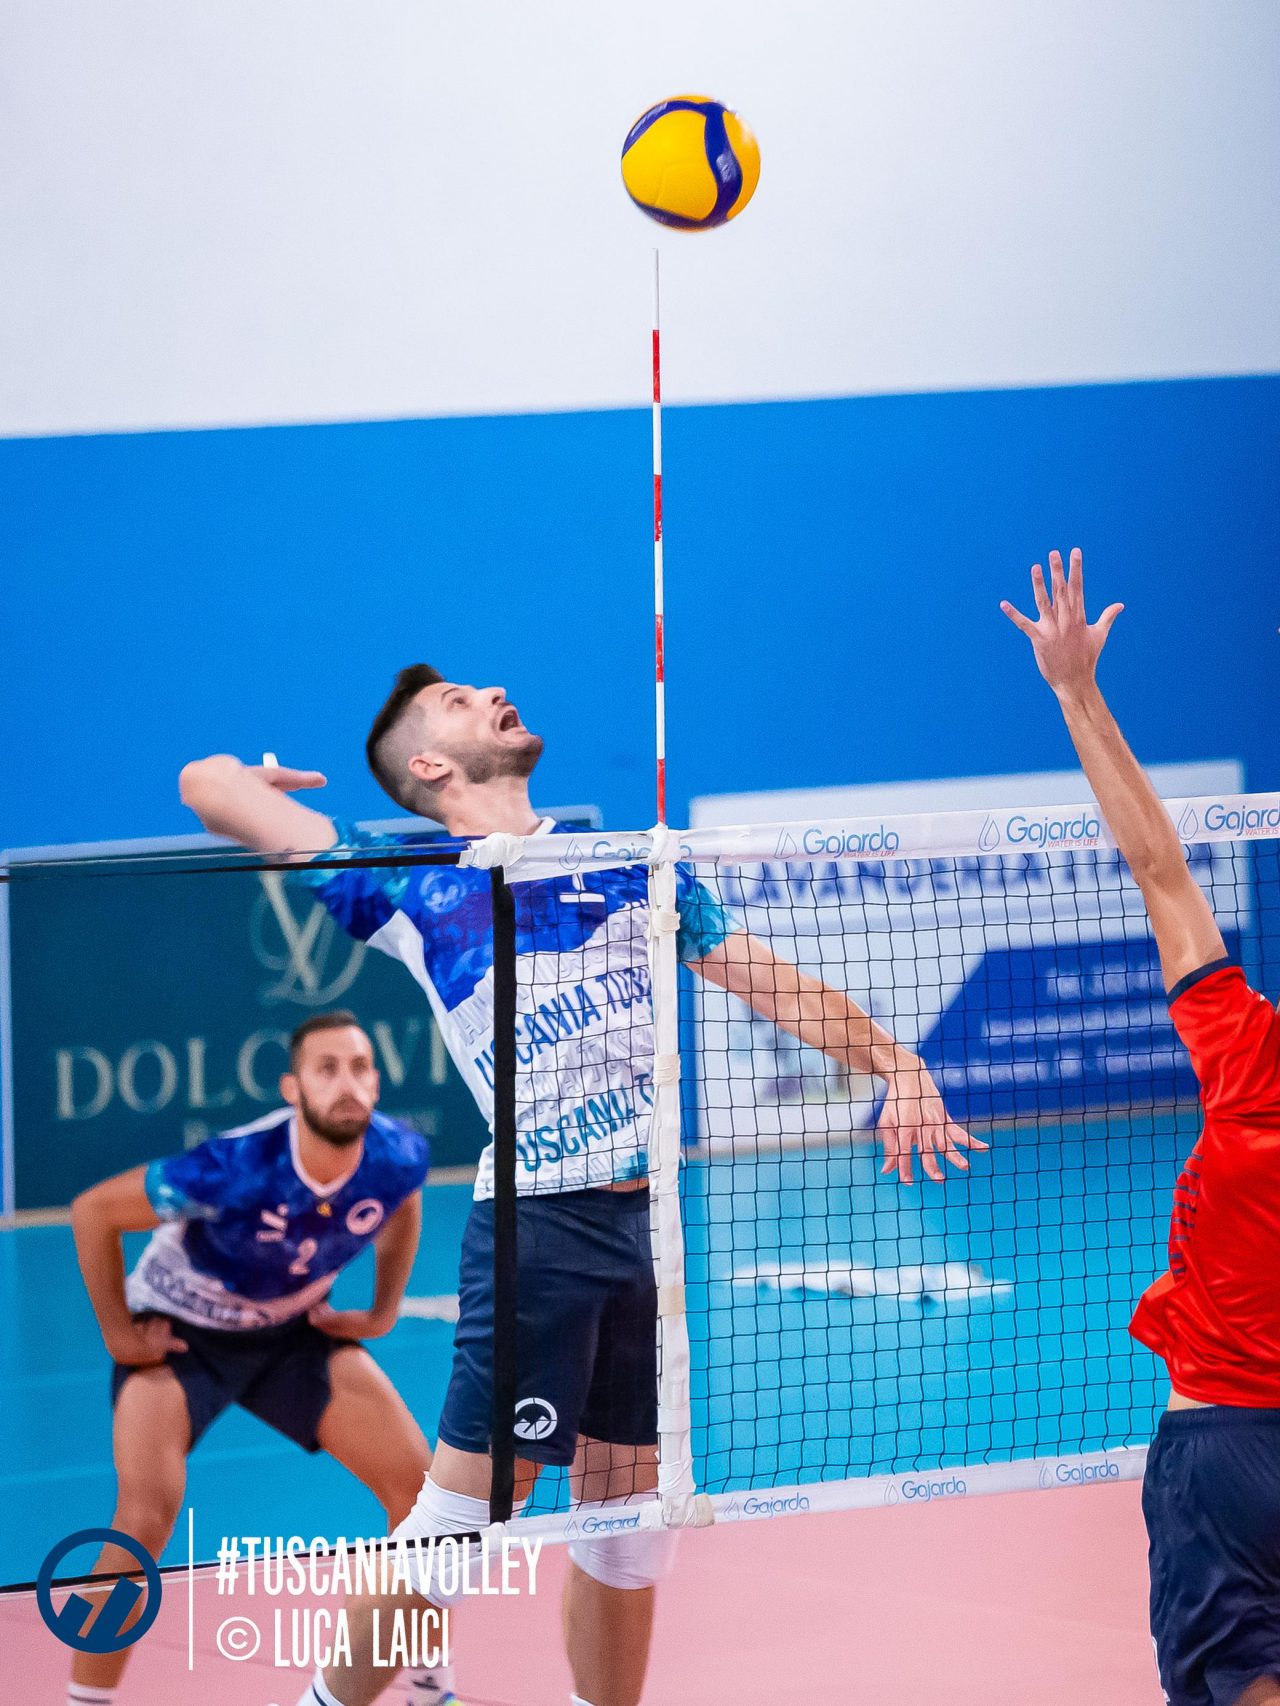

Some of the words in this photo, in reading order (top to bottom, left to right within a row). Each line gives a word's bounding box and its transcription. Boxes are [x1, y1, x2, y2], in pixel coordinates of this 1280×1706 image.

[803, 824, 900, 858] Gajarda
[1007, 813, 1100, 848] Gajarda
[1245, 827, 1271, 836] WATER
[1047, 840, 1075, 848] WATER
[1083, 838, 1098, 846] LIFE
[289, 1238, 318, 1275] 2
[1056, 1460, 1120, 1484] Gajarda
[901, 1477, 967, 1502] Gajarda
[743, 1493, 810, 1516] Gajarda
[582, 1512, 641, 1535] Gajard
